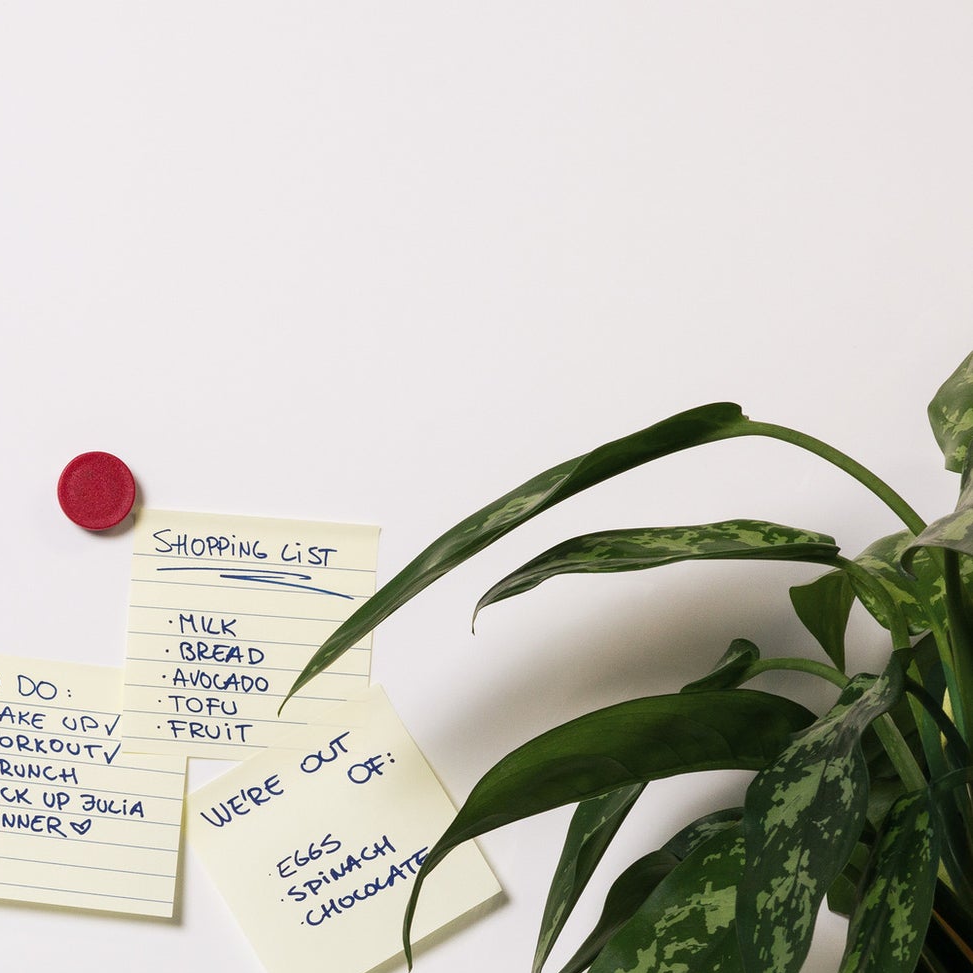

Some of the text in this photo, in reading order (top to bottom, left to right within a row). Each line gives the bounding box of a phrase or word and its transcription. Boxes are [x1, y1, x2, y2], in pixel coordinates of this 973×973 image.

[179, 613, 237, 637] MILK
[179, 641, 265, 665] BREAD
[172, 667, 269, 694] AVOCADO
[168, 695, 238, 716] TOFU
[61, 715, 100, 733] UP
[199, 730, 351, 829] WE'RE OUT
[346, 751, 396, 785] OF:
[42, 791, 71, 811] UP
[276, 832, 342, 879] EGGS
